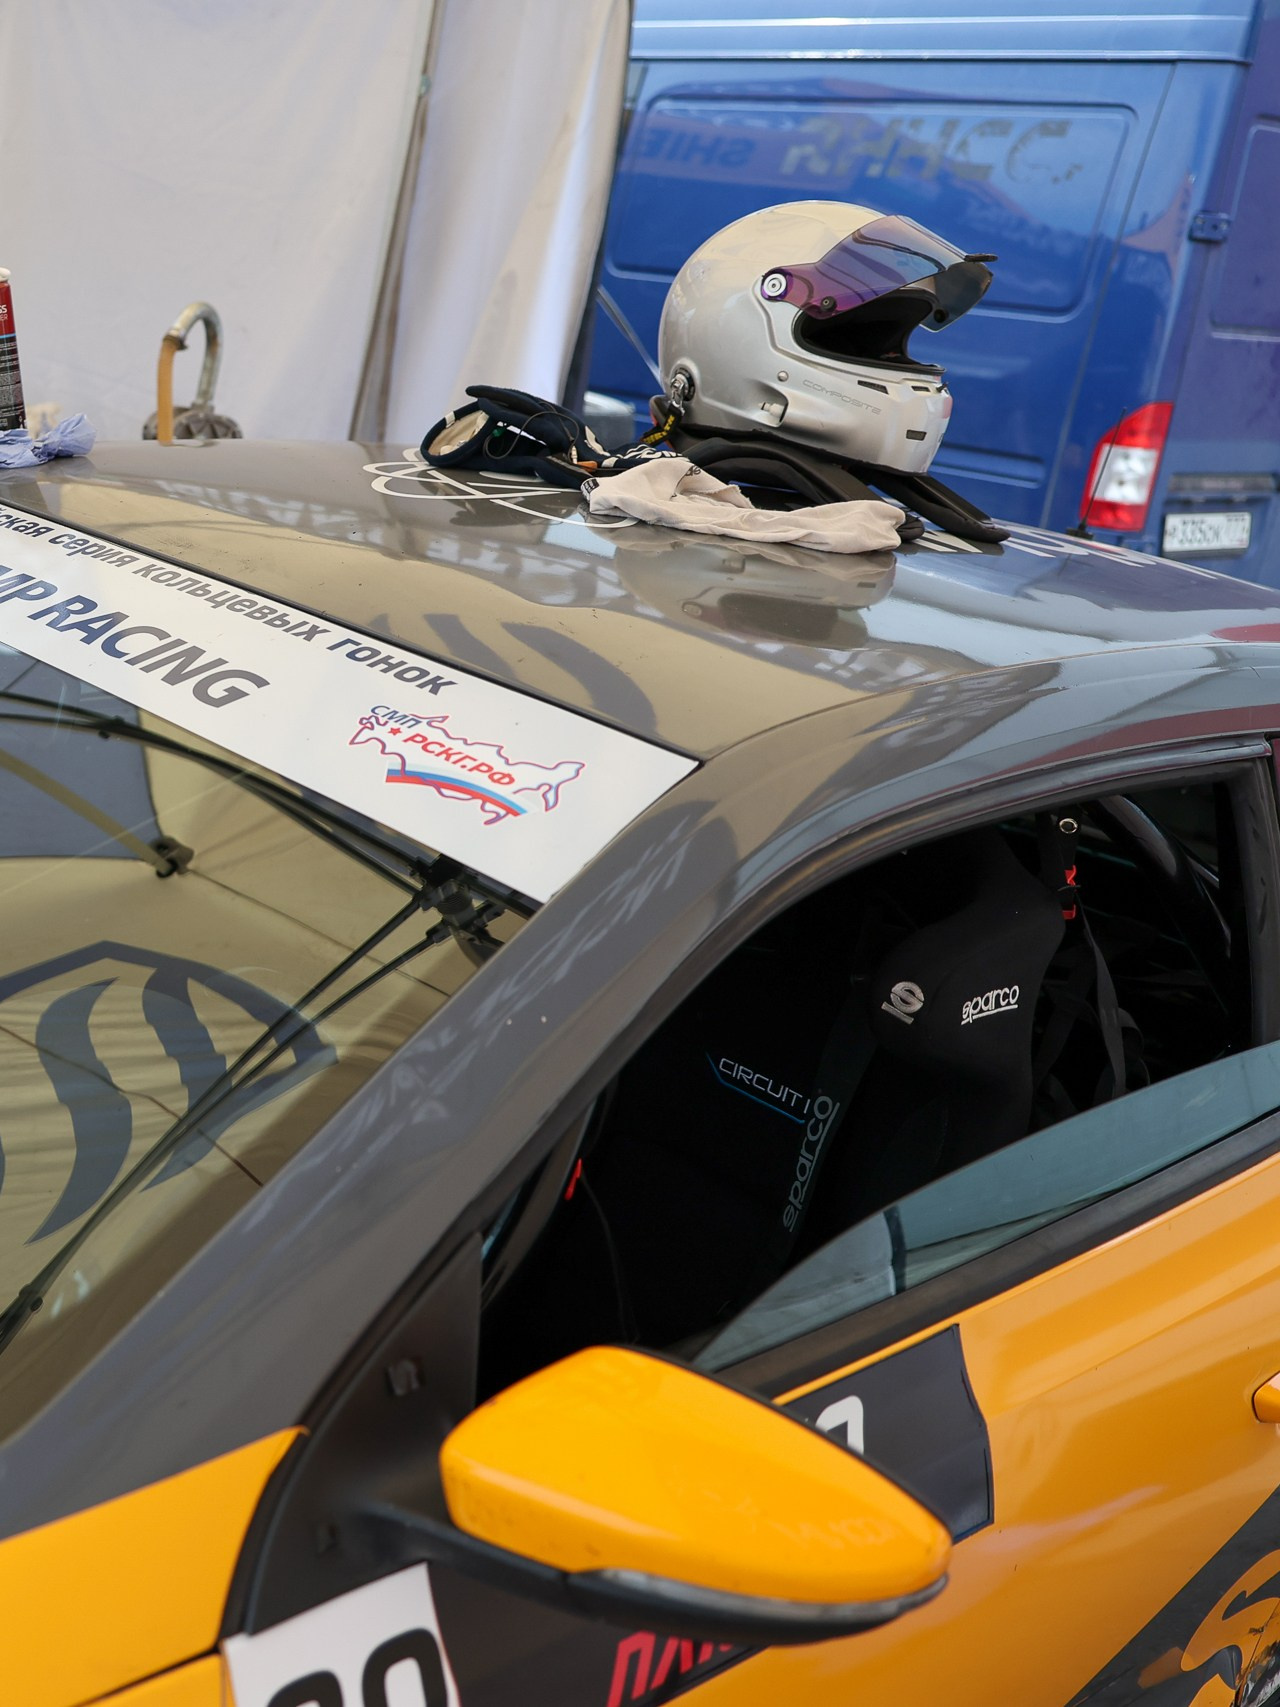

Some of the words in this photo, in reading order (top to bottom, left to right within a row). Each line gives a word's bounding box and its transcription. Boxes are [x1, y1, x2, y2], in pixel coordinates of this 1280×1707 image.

[803, 379, 882, 415] COMPOSITE
[48, 533, 141, 568] серия
[132, 563, 331, 642] кольцевых
[326, 638, 459, 696] гонок
[28, 595, 271, 708] RACING
[370, 705, 423, 729] СМП
[402, 733, 516, 785] РСКГ.РФ
[962, 985, 1019, 1025] sparco
[719, 1058, 803, 1107] CIRCUIT
[783, 1096, 837, 1232] sparco
